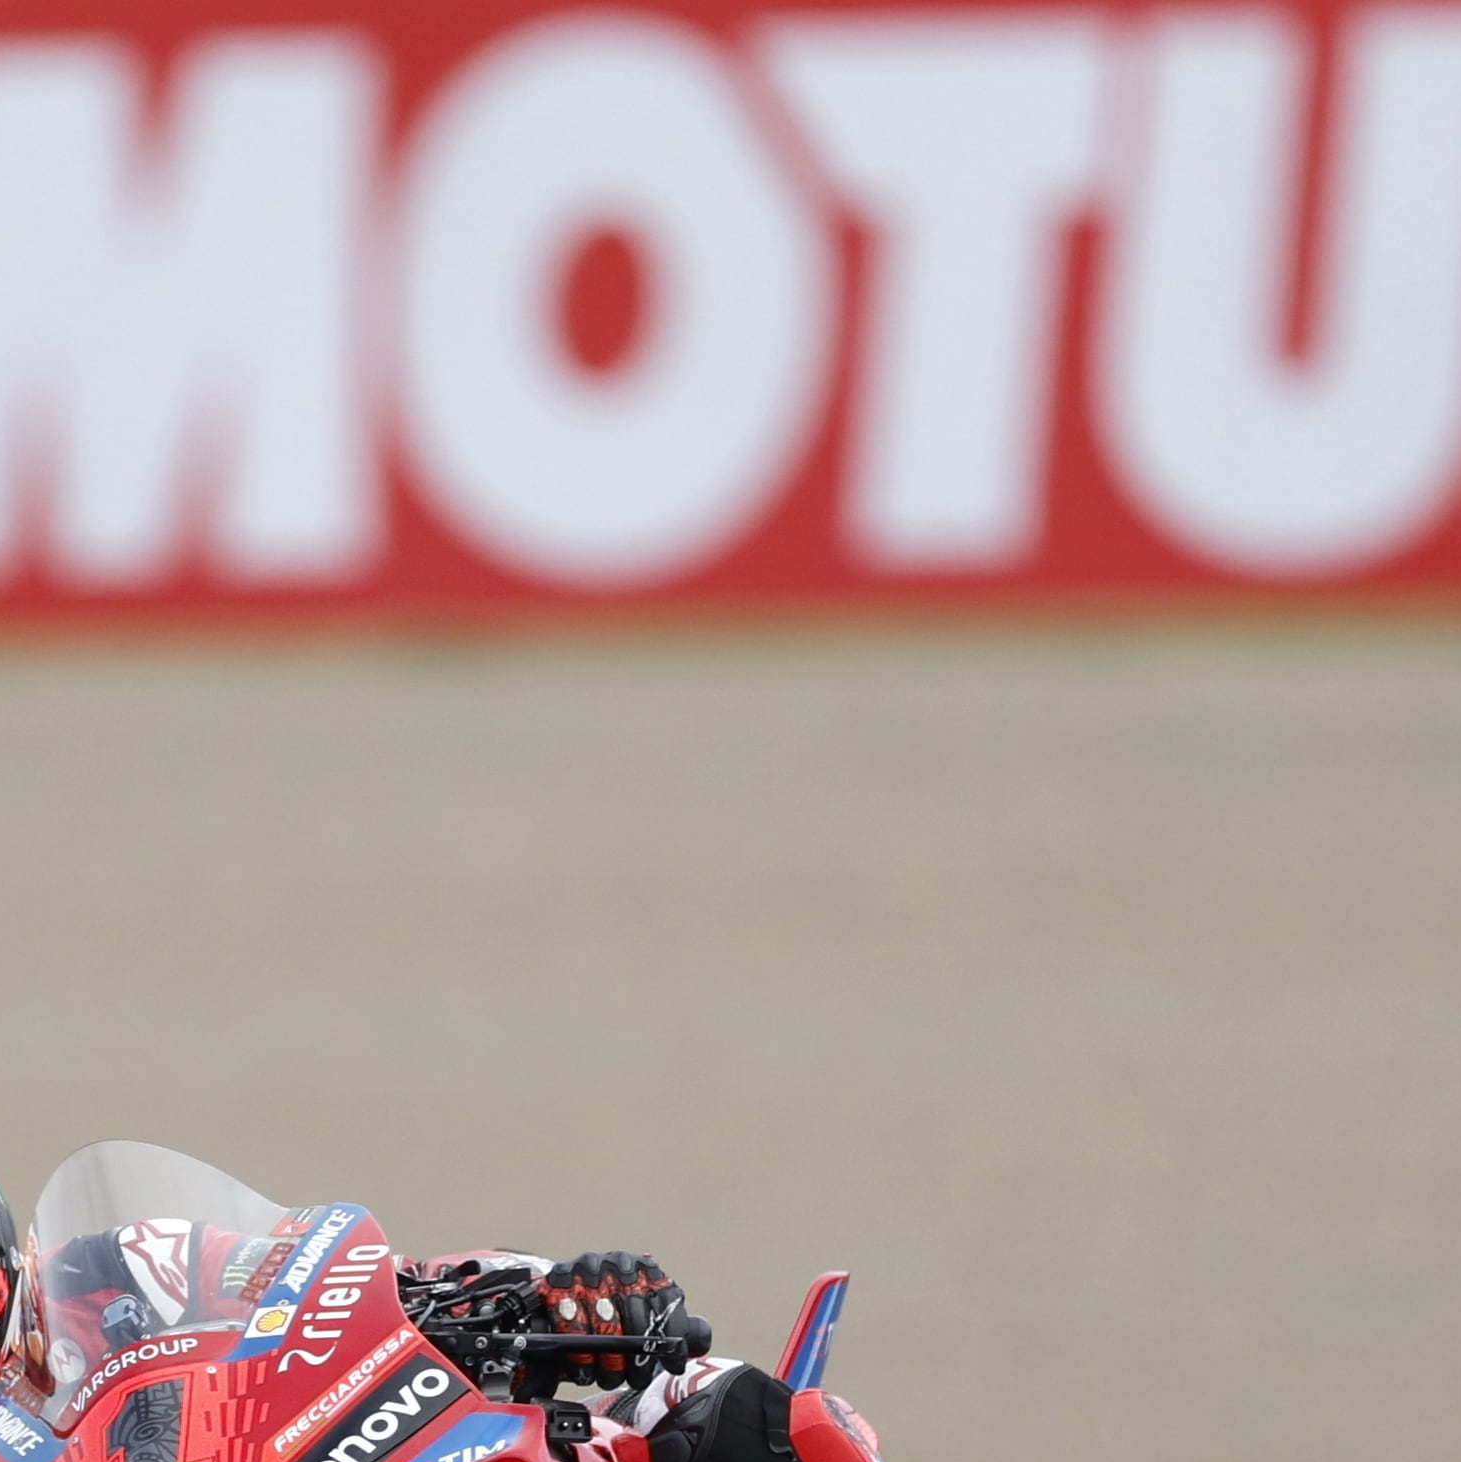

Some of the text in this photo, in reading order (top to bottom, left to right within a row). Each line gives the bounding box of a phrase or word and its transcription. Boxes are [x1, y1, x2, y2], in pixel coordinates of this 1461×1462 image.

[288, 1208, 355, 1294] ADVANCE
[300, 1243, 390, 1340] riello
[273, 1327, 415, 1454] FRECCIAROSSA
